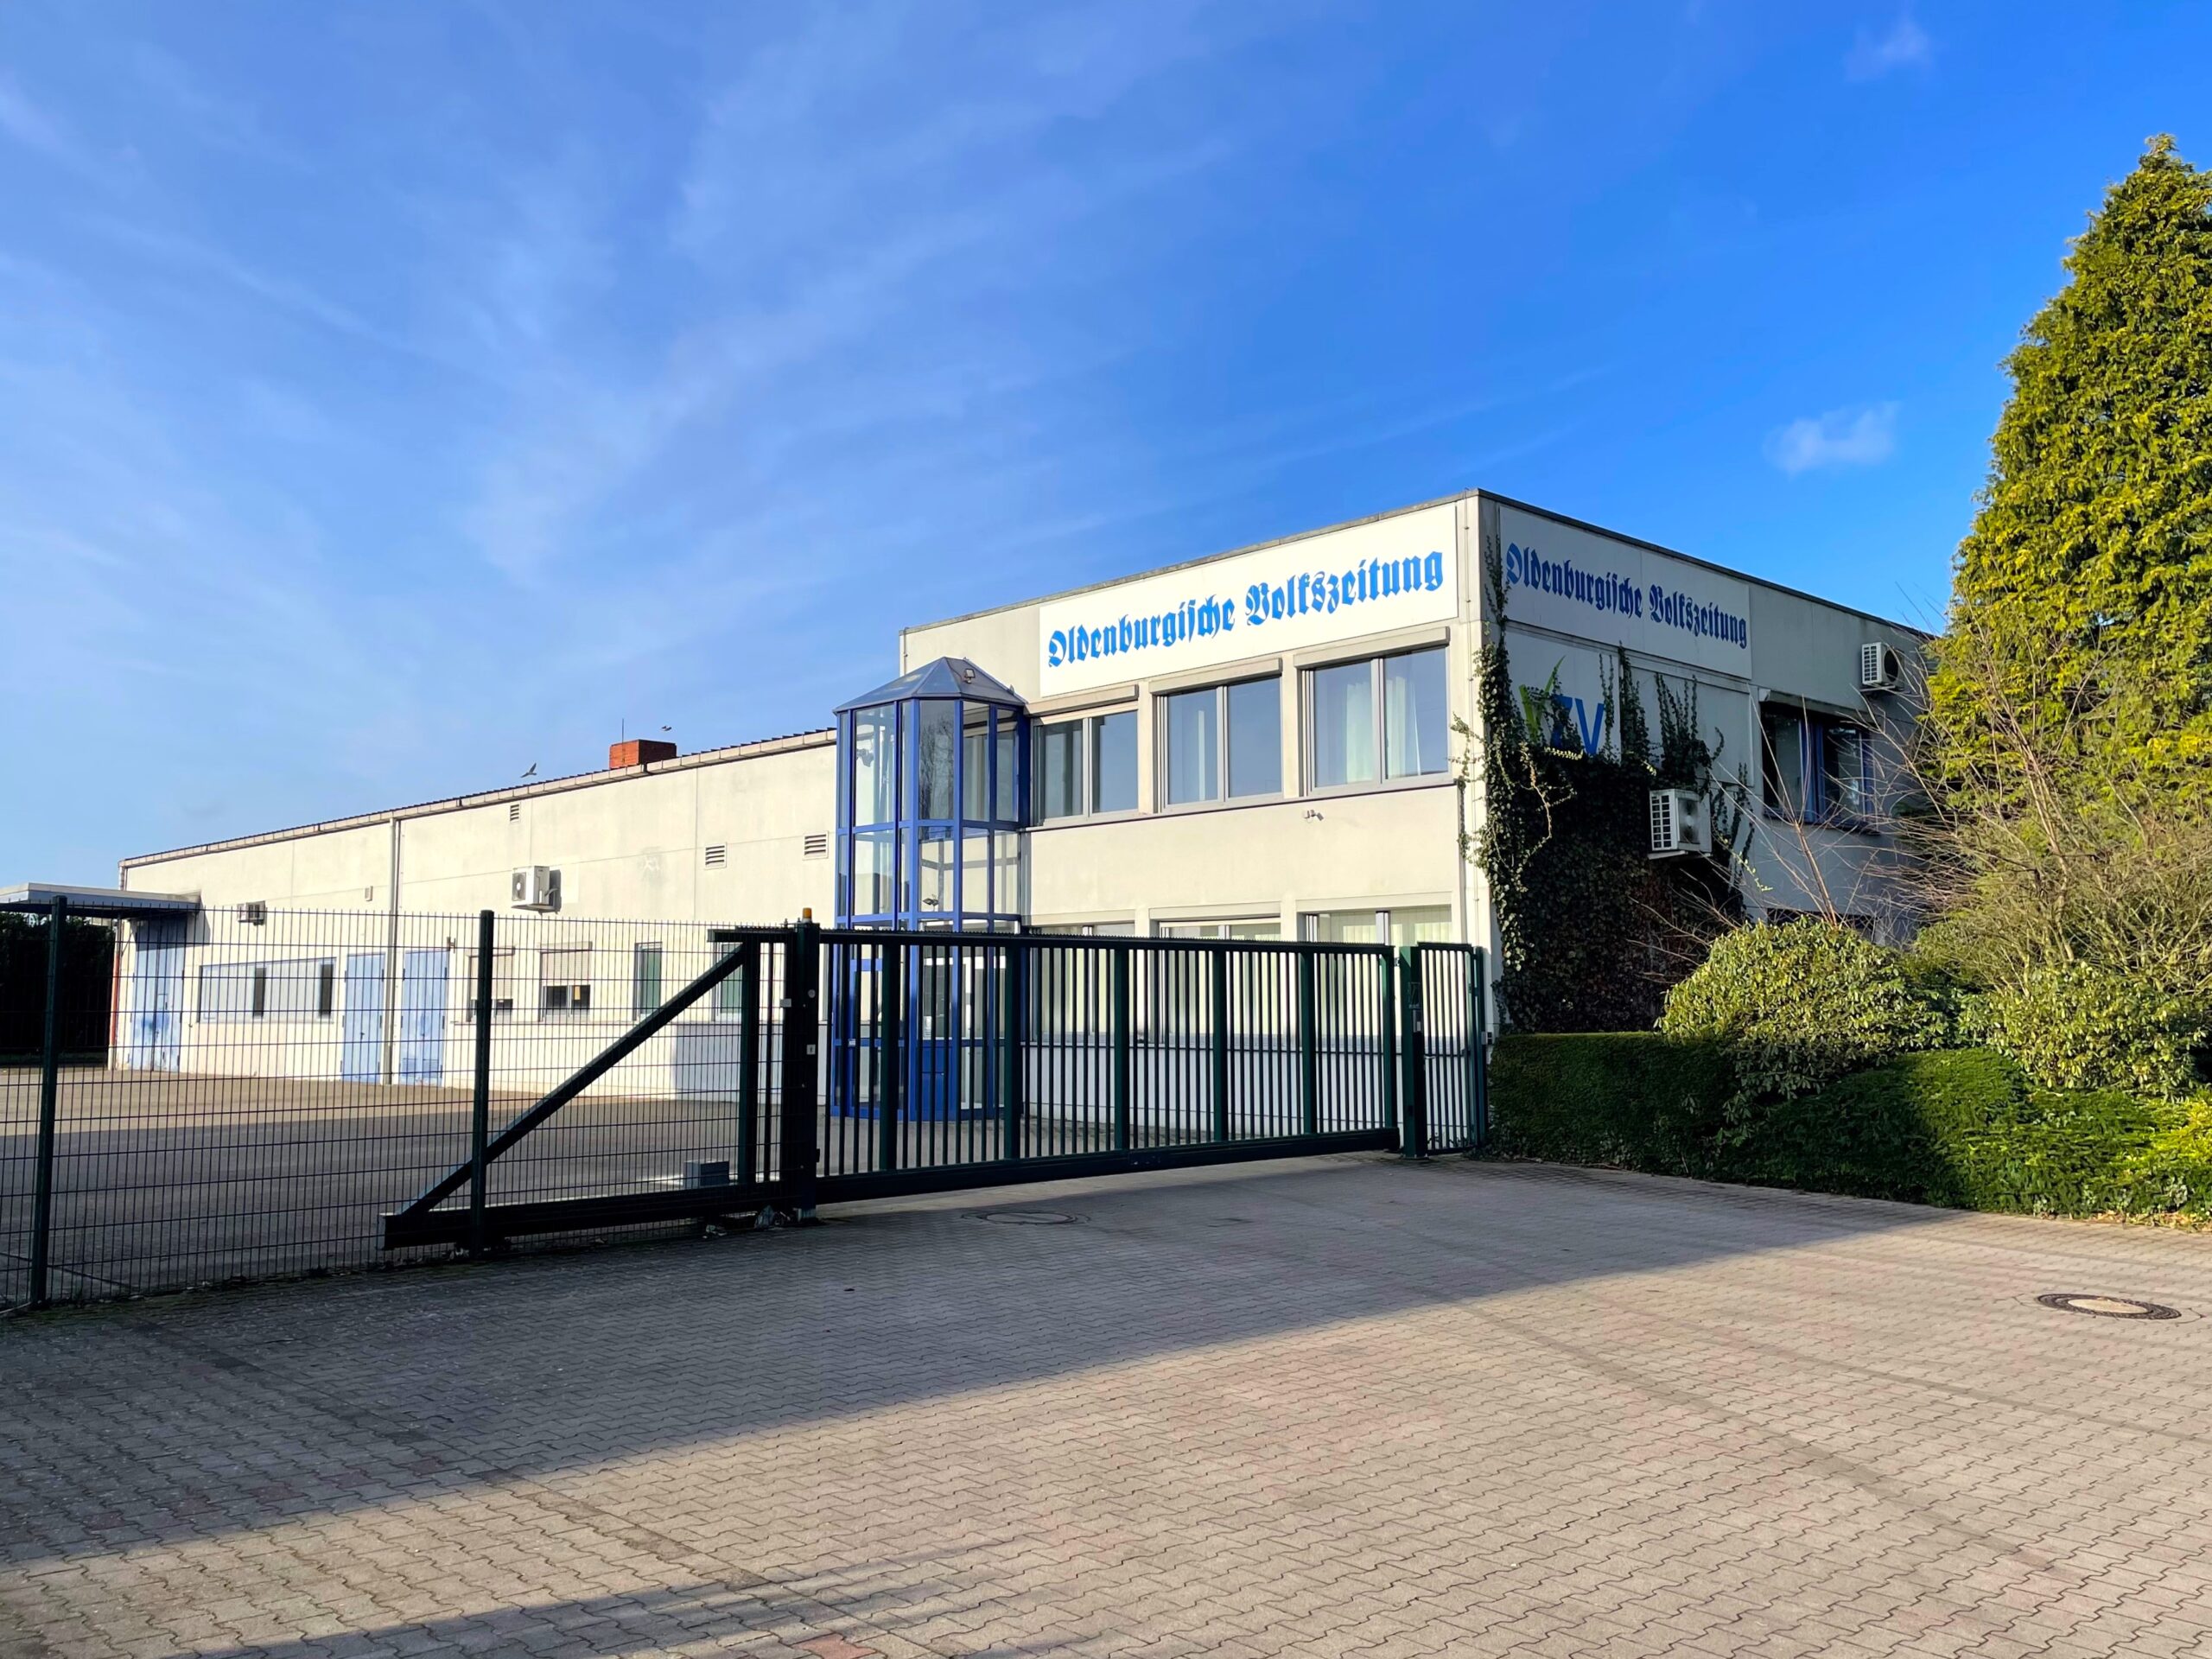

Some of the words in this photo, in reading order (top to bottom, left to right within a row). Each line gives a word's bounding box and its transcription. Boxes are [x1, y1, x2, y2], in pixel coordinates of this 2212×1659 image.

[1048, 594, 1235, 668] Oldenburgische
[1245, 551, 1444, 626] Volkszeitung
[1506, 543, 1643, 618] Oldenburgische
[1649, 584, 1747, 649] Volkszeitung
